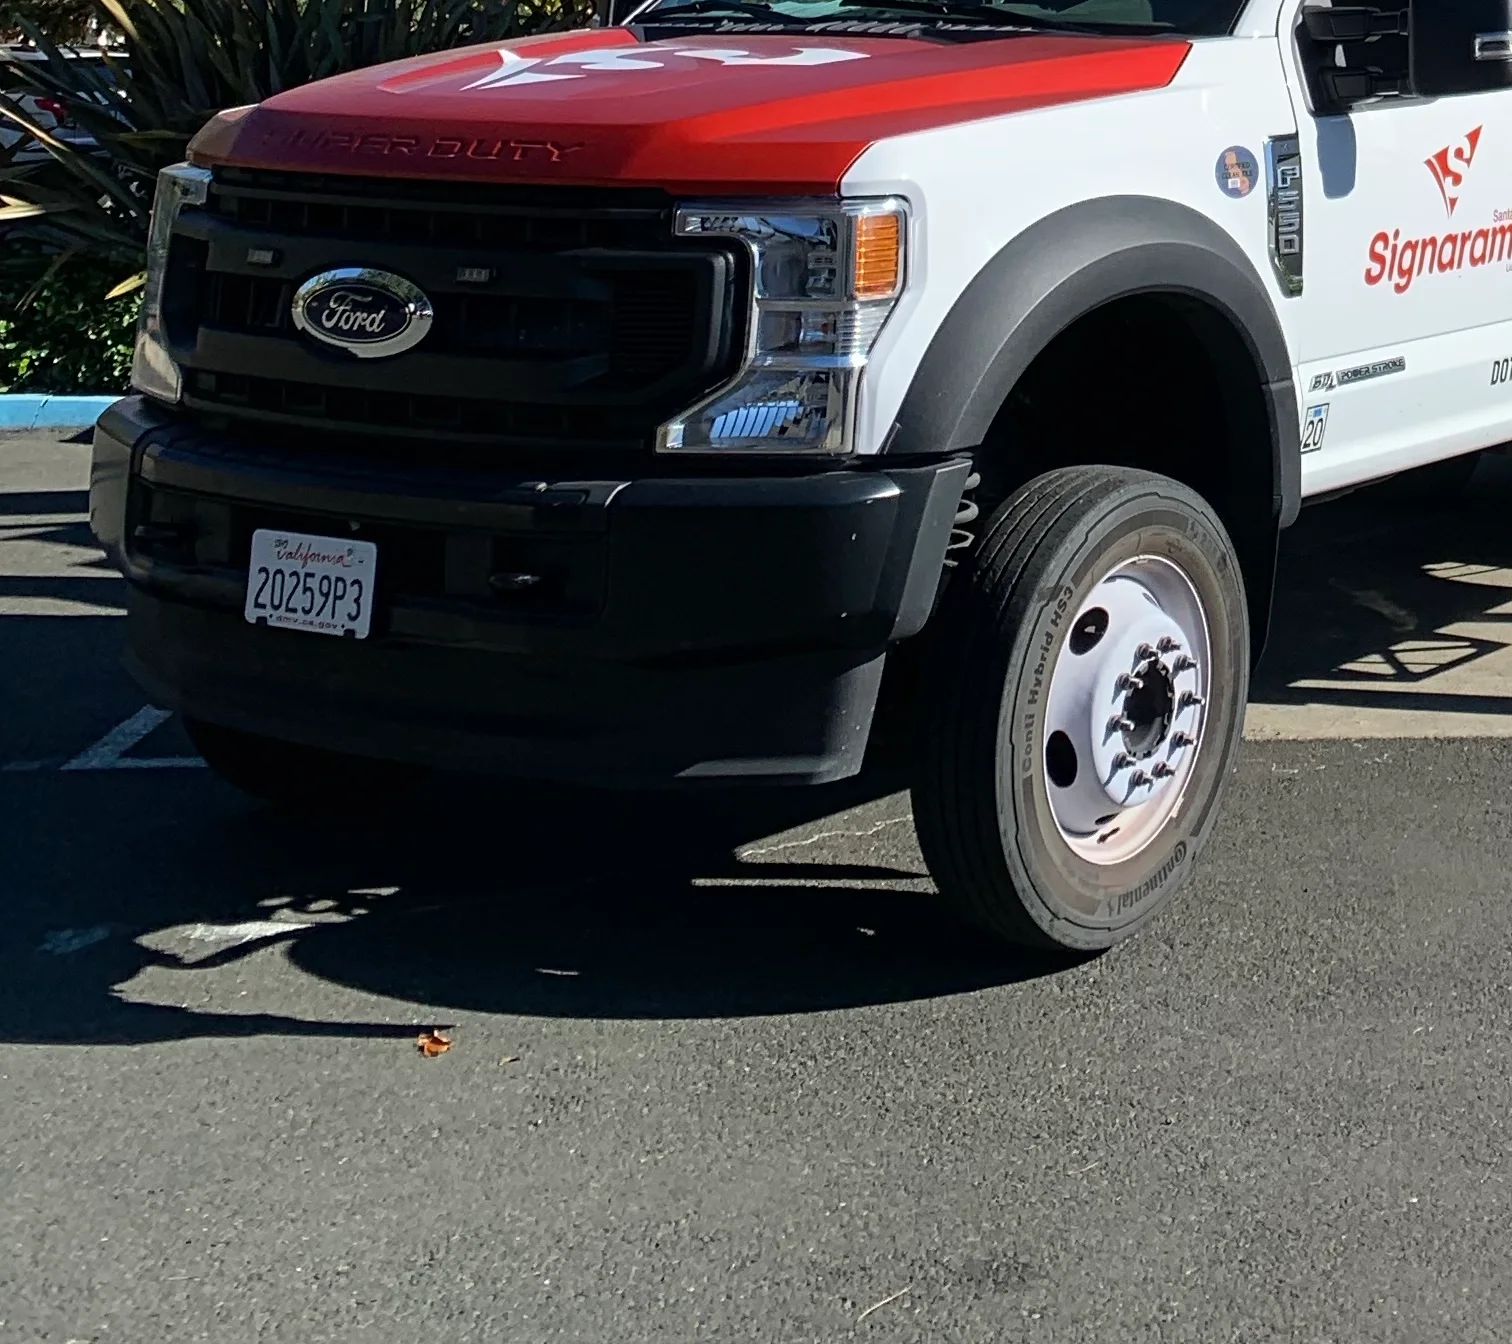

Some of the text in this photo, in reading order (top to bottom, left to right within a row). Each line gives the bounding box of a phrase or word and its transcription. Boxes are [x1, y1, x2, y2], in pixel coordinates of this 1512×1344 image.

[427, 138, 586, 162] DUTY
[321, 291, 386, 333] Ford
[1371, 358, 1405, 374] STROKE
[1301, 417, 1324, 450] 20
[277, 541, 352, 569] California
[253, 566, 363, 622] 20259P3
[1027, 630, 1054, 705] Hybrid
[1050, 585, 1074, 628] HS3
[1116, 840, 1187, 916] Continental
